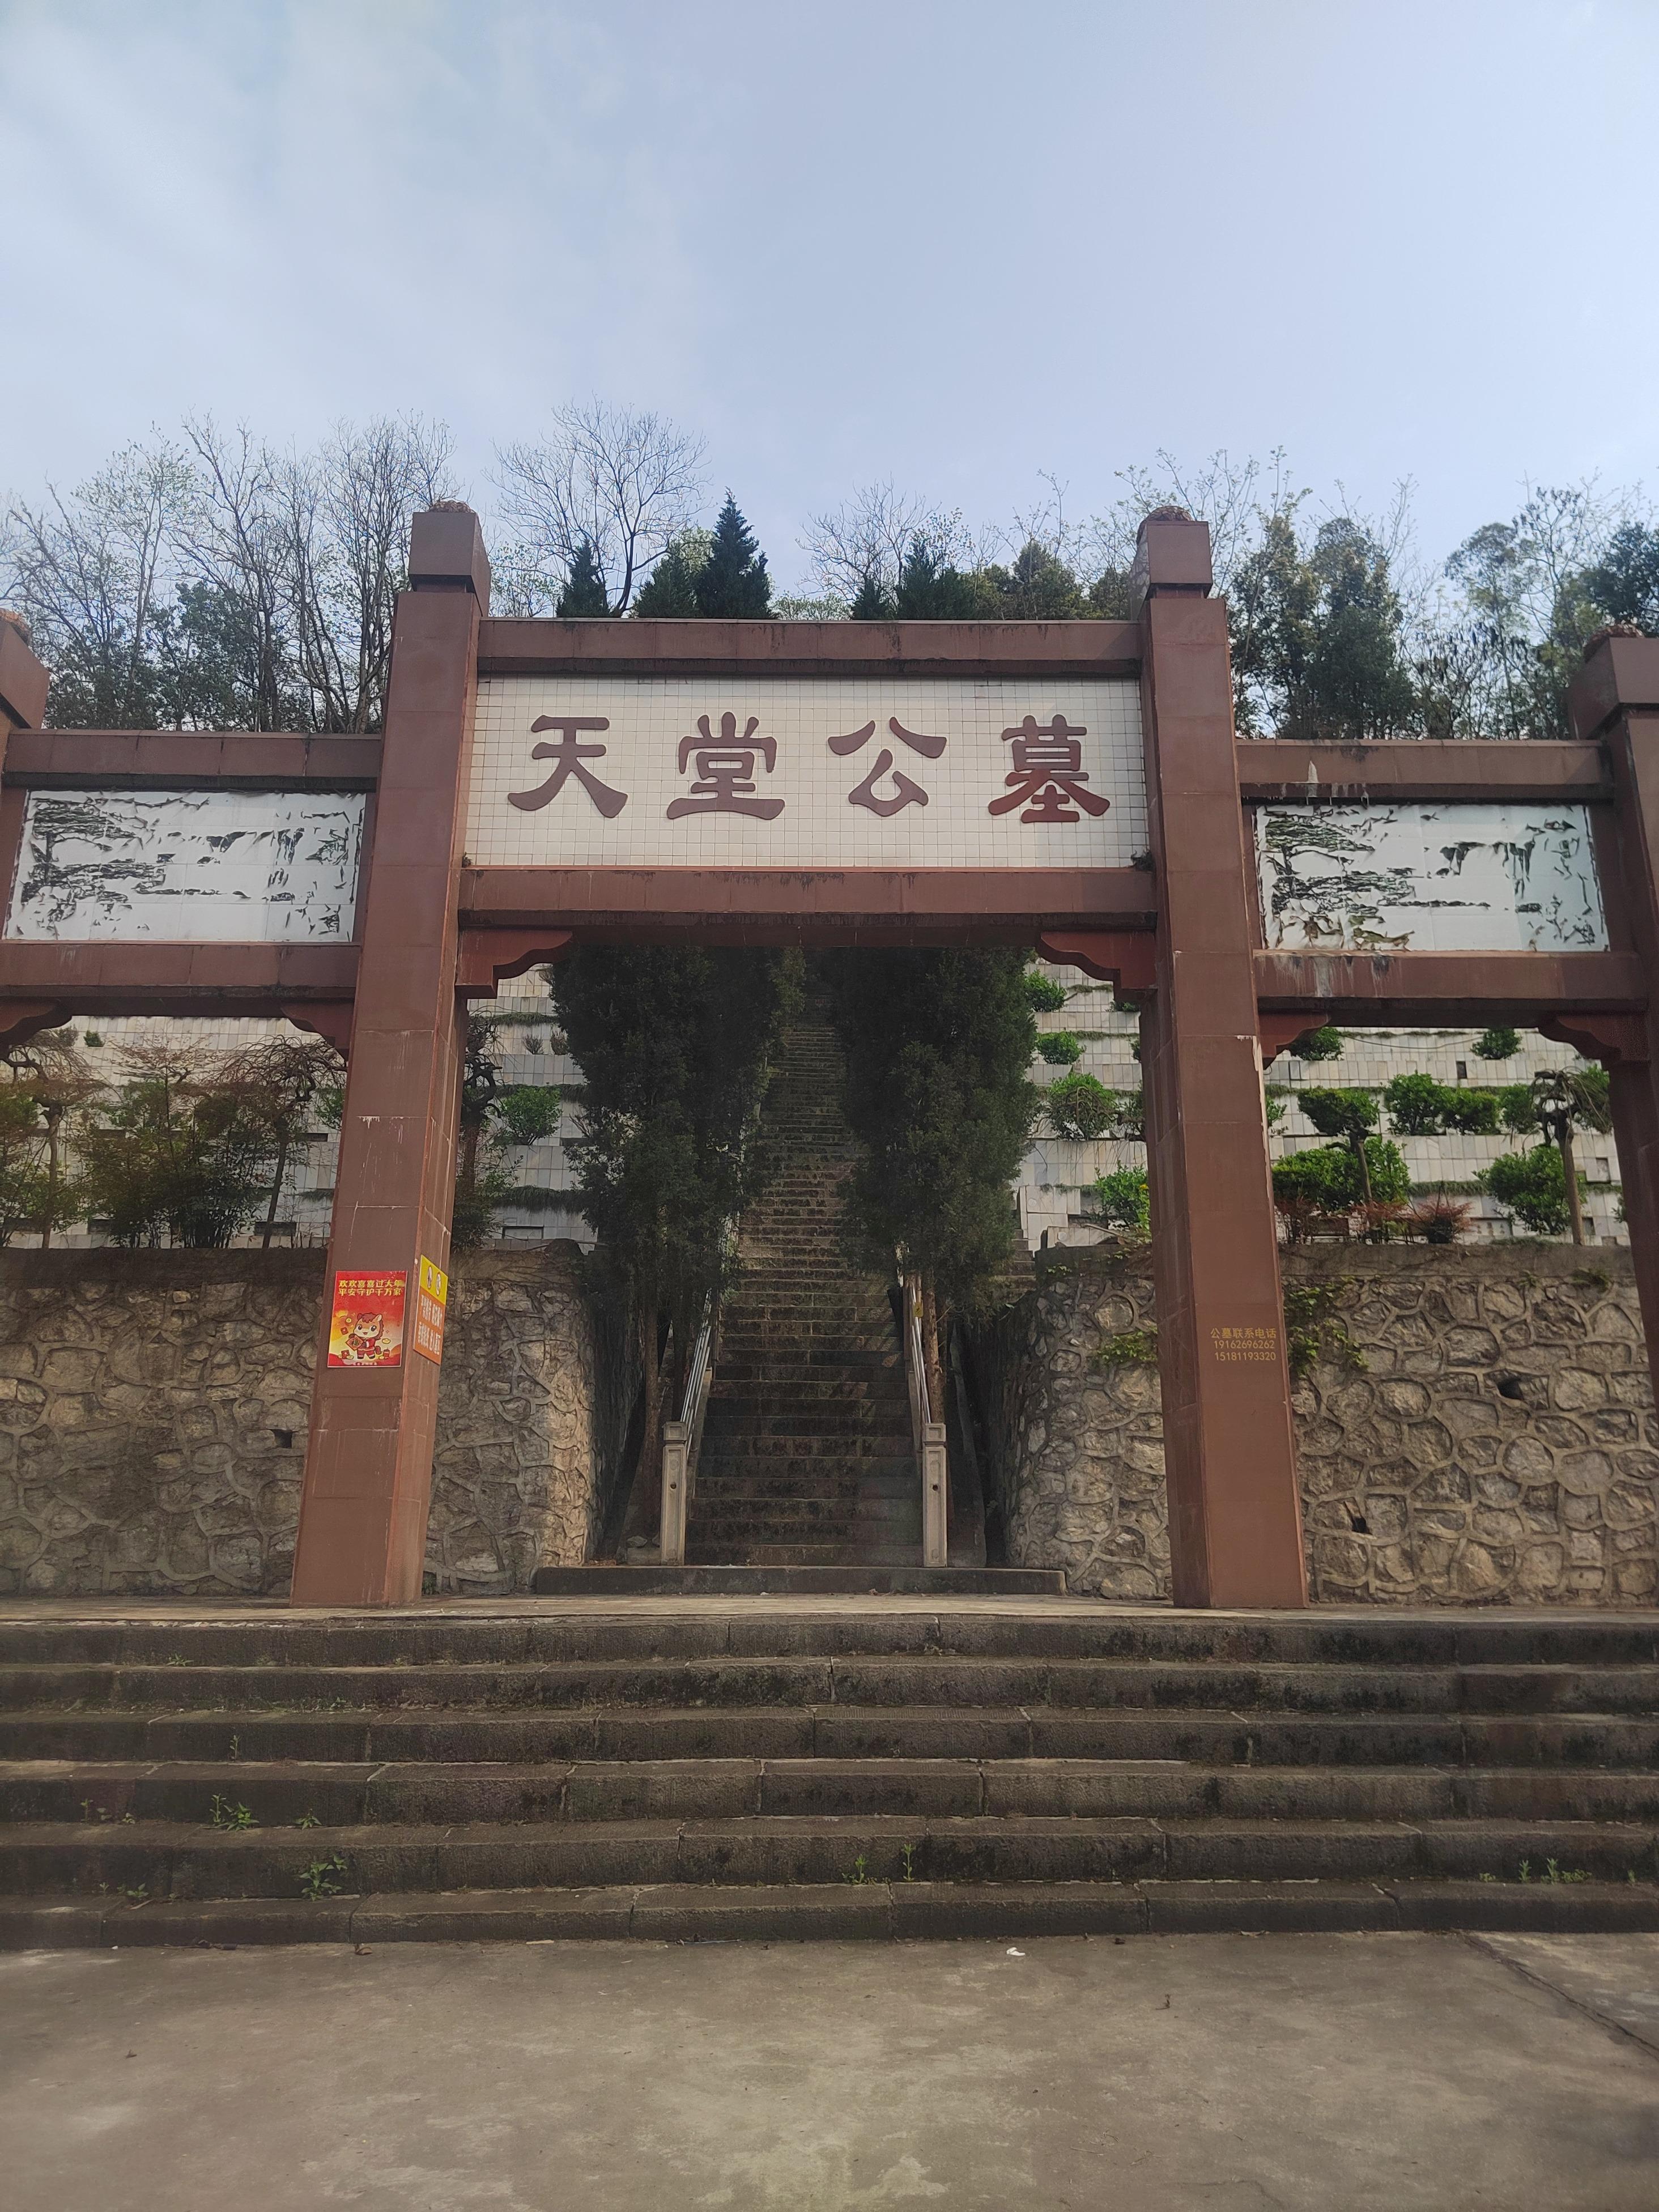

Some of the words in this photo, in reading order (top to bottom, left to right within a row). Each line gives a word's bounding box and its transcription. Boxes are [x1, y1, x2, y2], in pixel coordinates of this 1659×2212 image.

[507, 711, 1111, 823] 天堂公墓
[338, 1279, 403, 1288] 欢欢喜喜过大年
[338, 1288, 402, 1296] 平安守护千万家
[1210, 1328, 1277, 1339] 公墓联系电话
[1214, 1340, 1274, 1349] 19162696262
[1215, 1352, 1276, 1360] 15181193320
